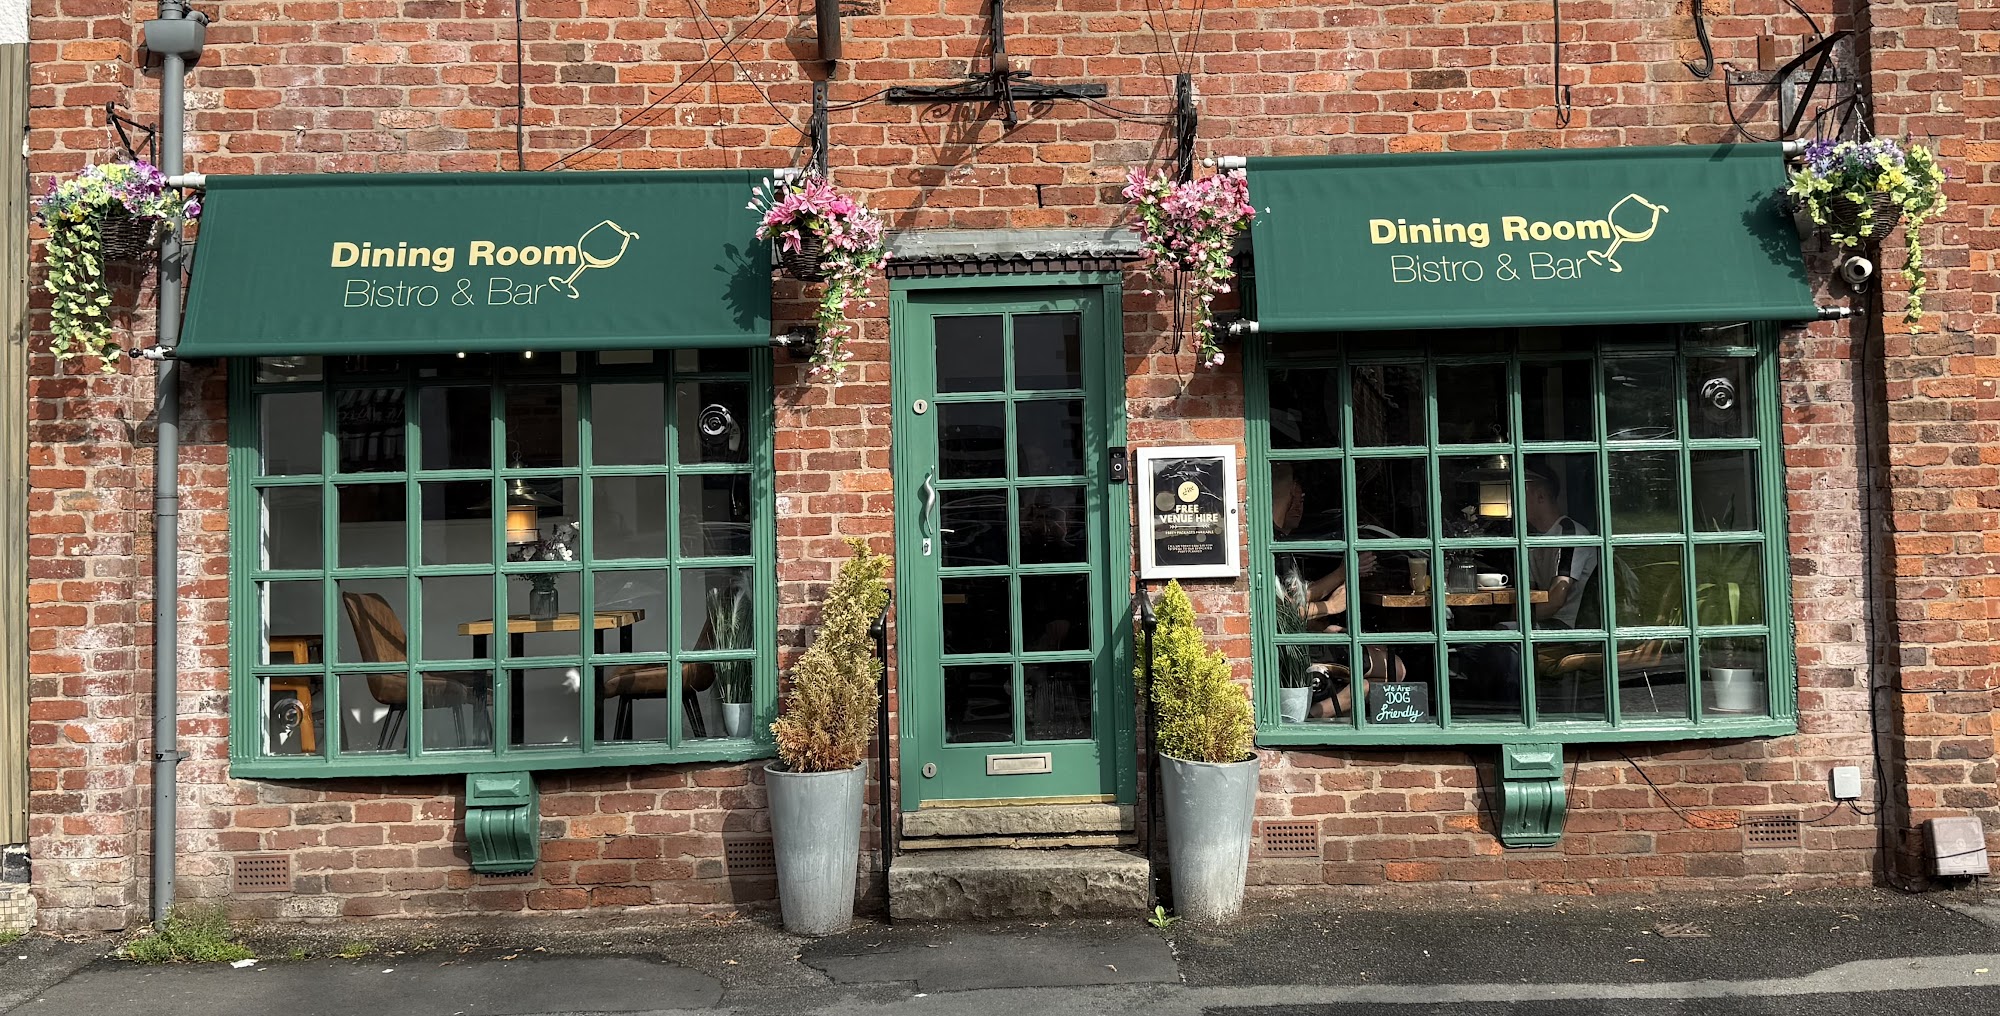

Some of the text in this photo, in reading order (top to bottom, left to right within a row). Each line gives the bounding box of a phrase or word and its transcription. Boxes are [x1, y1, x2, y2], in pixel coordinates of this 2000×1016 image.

[1369, 216, 1611, 248] Dining Room
[331, 240, 577, 273] Dining Room
[1391, 252, 1587, 283] Bistro & Bar
[343, 277, 547, 308] Bistro & Bar
[1159, 514, 1218, 524] VENUE HIRE
[1176, 505, 1199, 513] FREE
[1385, 692, 1410, 704] DOG
